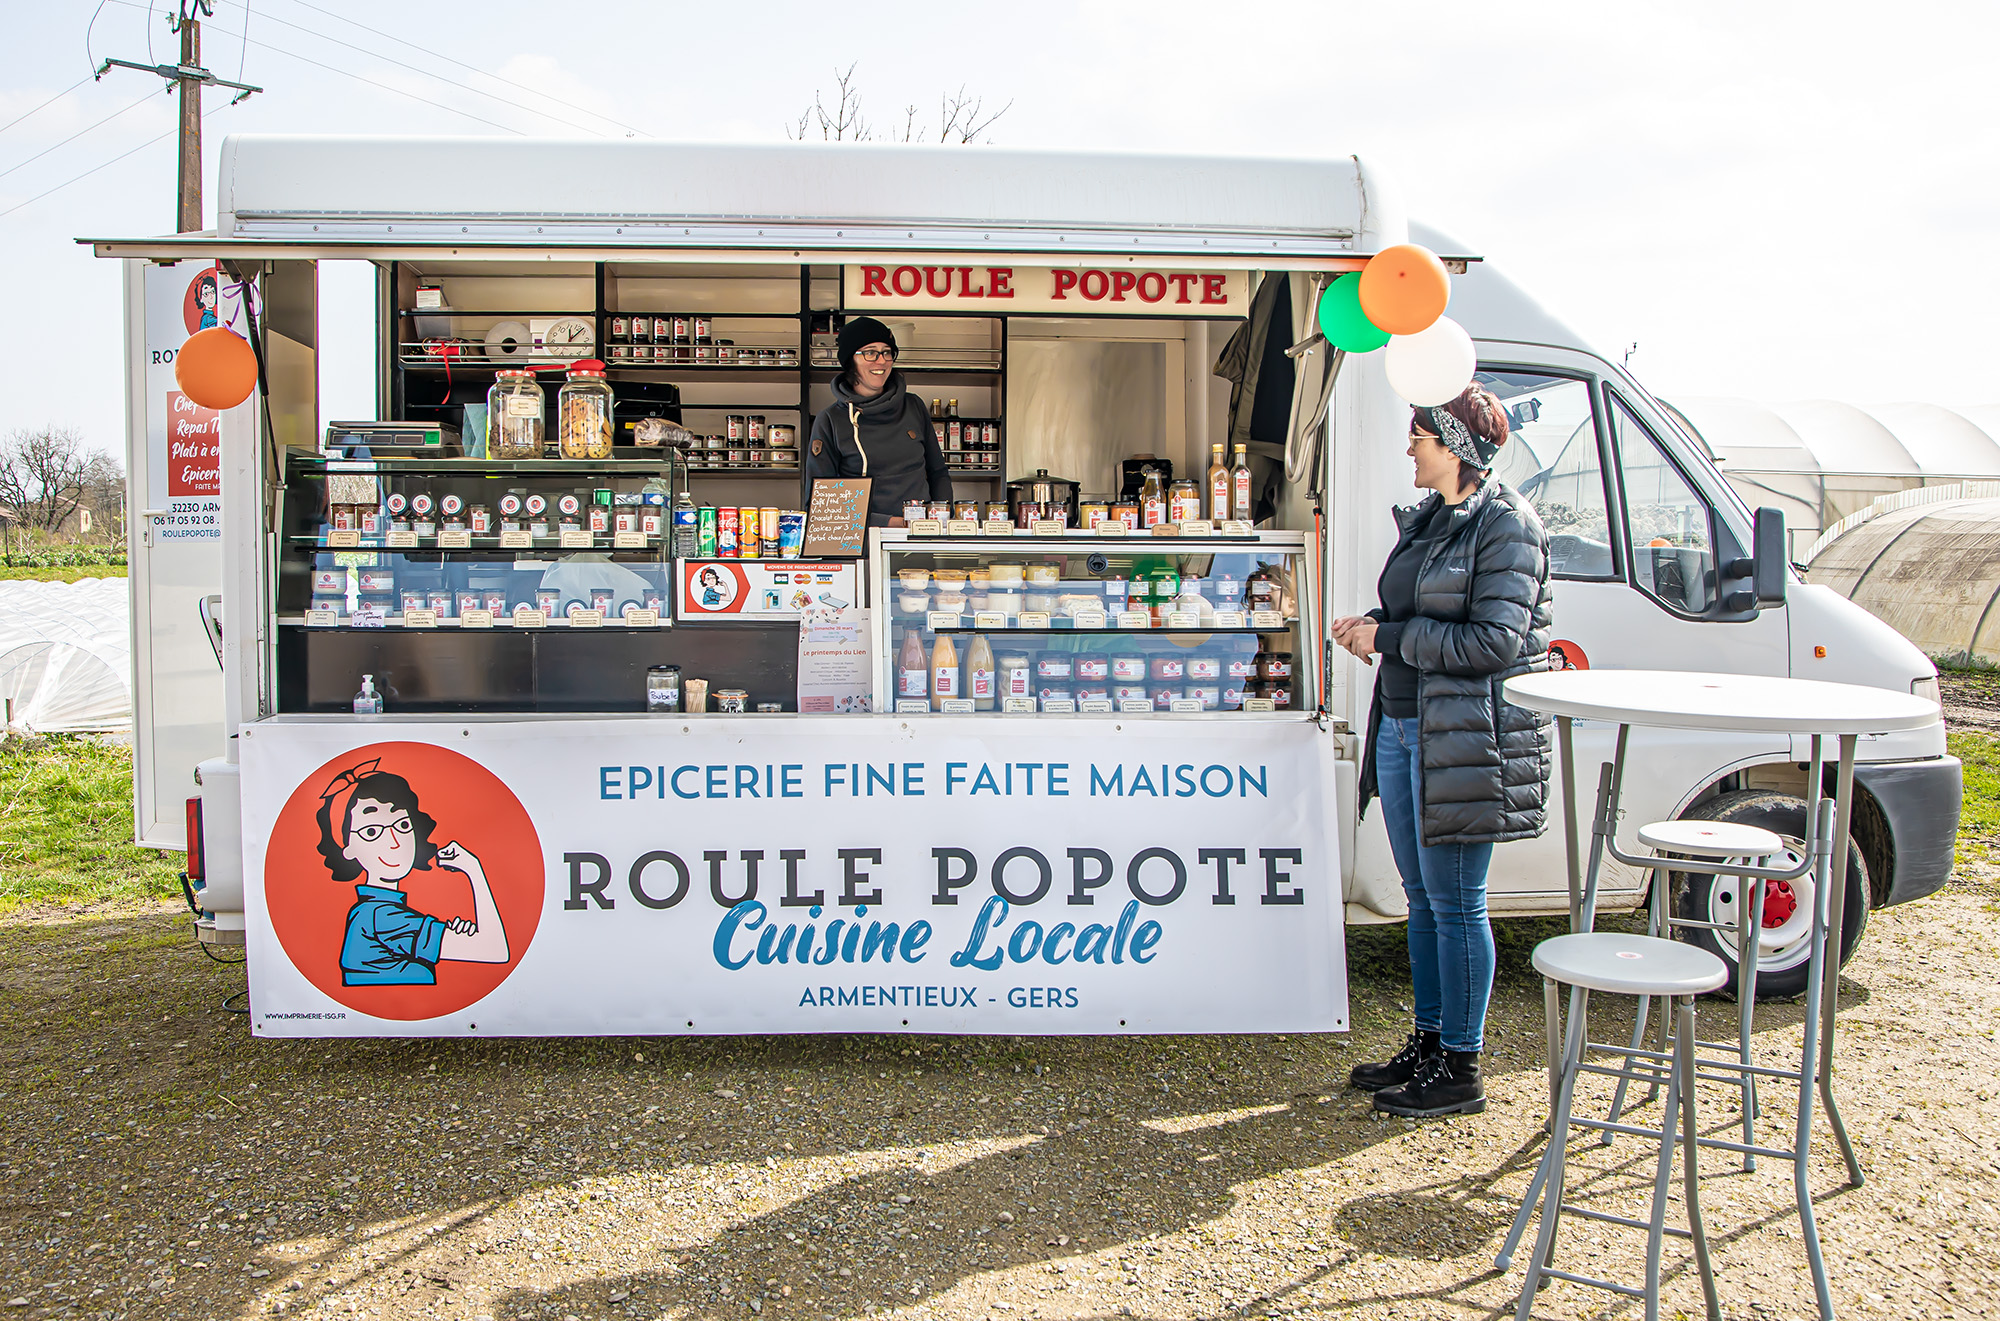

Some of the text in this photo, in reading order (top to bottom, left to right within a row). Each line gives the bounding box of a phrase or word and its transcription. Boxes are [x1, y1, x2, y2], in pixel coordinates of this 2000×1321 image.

[860, 265, 1229, 305] ROULE POPOTE
[152, 349, 180, 364] RO
[177, 419, 208, 438] Repas
[172, 439, 198, 459] Plats
[201, 443, 208, 457] à
[182, 464, 220, 485] Epiceri
[172, 502, 200, 513] 32230
[154, 516, 166, 526] 06
[167, 516, 175, 525] 17
[177, 516, 189, 525] 05
[191, 515, 200, 525] 92
[202, 515, 215, 524] 08
[811, 649, 842, 657] printemps
[600, 762, 1269, 800] EPICERIE FINE FAITE MAISON
[563, 846, 1305, 911] ROULE POPOTE
[712, 895, 1163, 971] Cuisine Locale
[799, 986, 978, 1008] ARMENTIEUX
[1007, 987, 1079, 1008] GERS
[264, 1012, 347, 1020] WWW.IMPRIMERIE-ISG.FR
